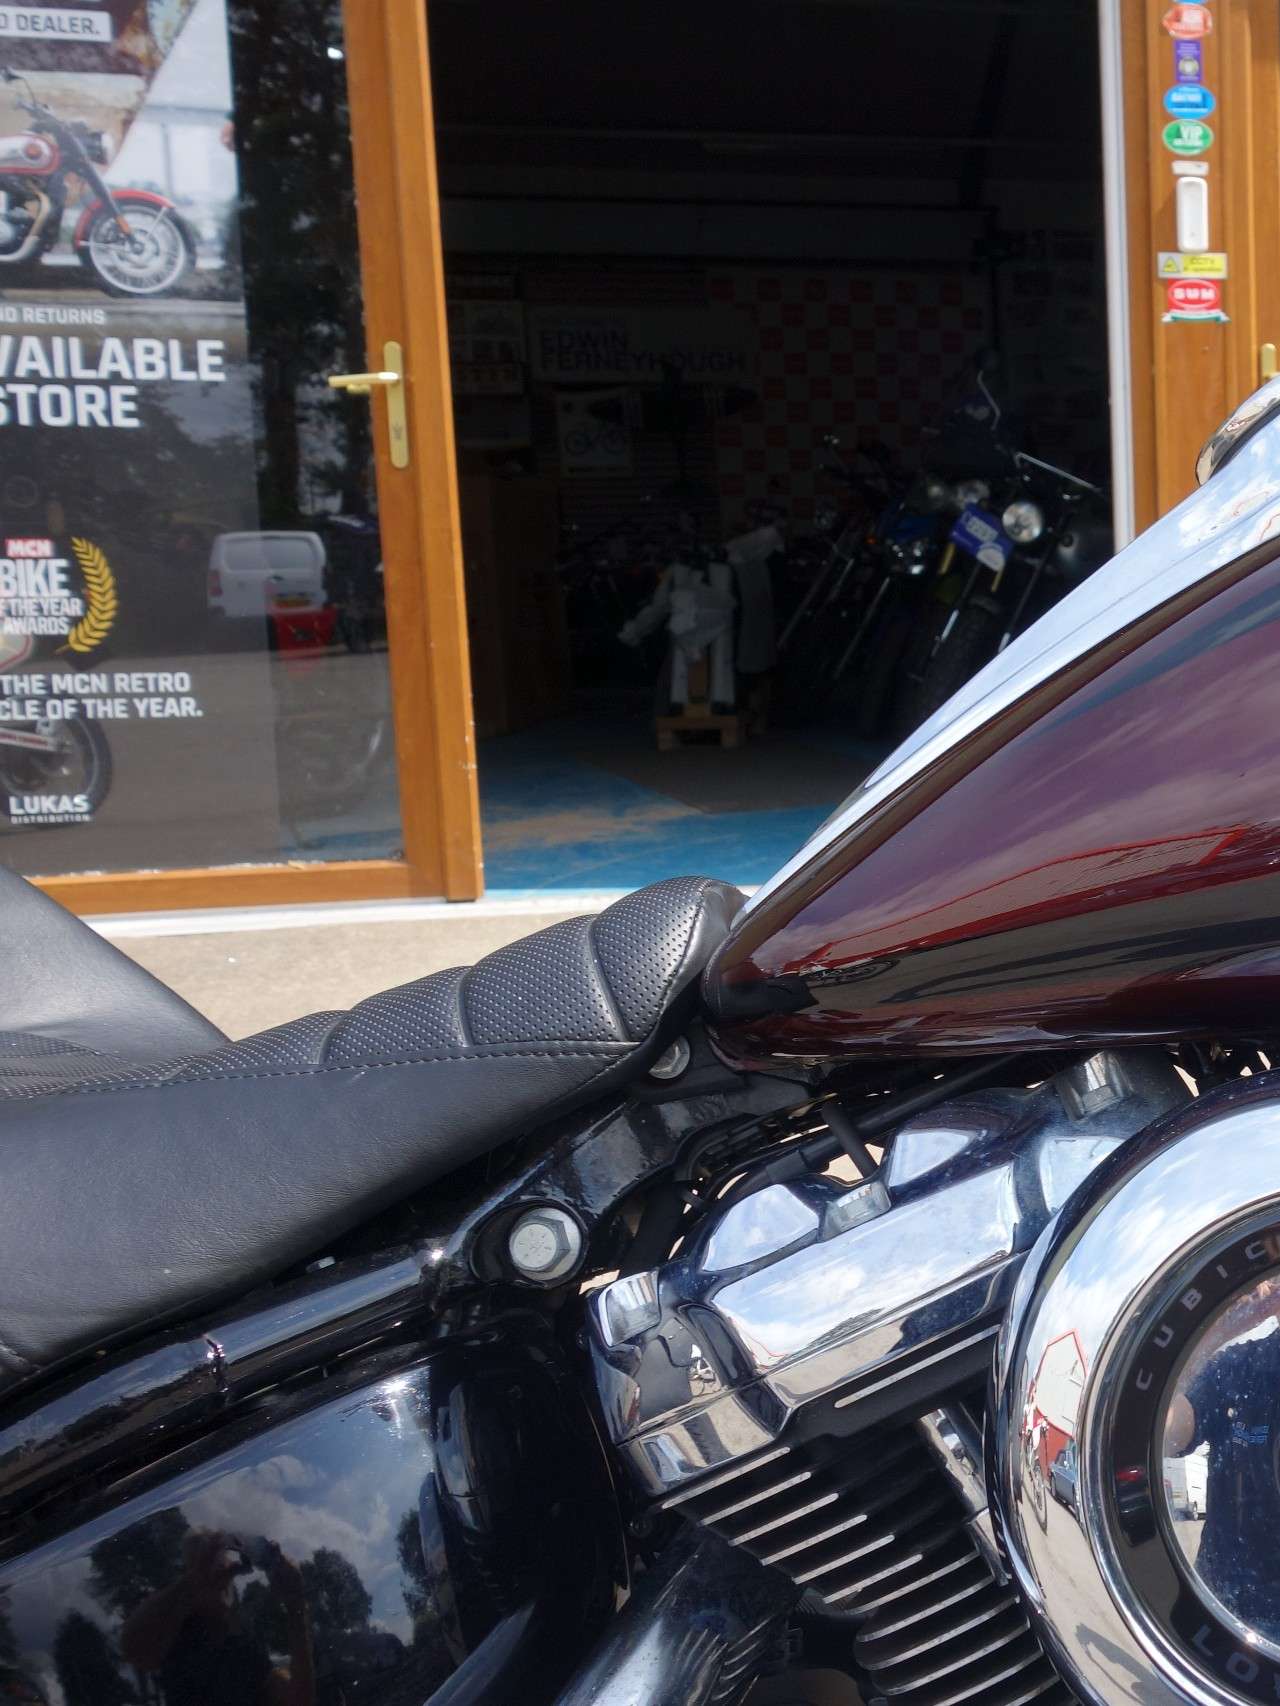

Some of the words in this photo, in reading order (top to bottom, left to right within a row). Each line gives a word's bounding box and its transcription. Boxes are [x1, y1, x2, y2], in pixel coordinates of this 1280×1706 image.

[16, 14, 100, 34] DEALER.
[23, 307, 106, 325] RETURNS
[8, 540, 52, 557] MCN
[0, 558, 70, 597] BIKE
[9, 599, 41, 616] THE
[39, 598, 83, 616] YEAR
[3, 616, 69, 635] AWARDS
[1, 674, 47, 695] THE
[52, 673, 109, 694] MCN
[113, 672, 192, 693] RETRO
[46, 699, 77, 720] OF
[81, 698, 129, 719] THE
[133, 696, 203, 719] YEAR.
[9, 794, 89, 815] LUKAS
[11, 814, 91, 824] DISTRIBUTION
[1135, 1240, 1266, 1391] CUBIC
